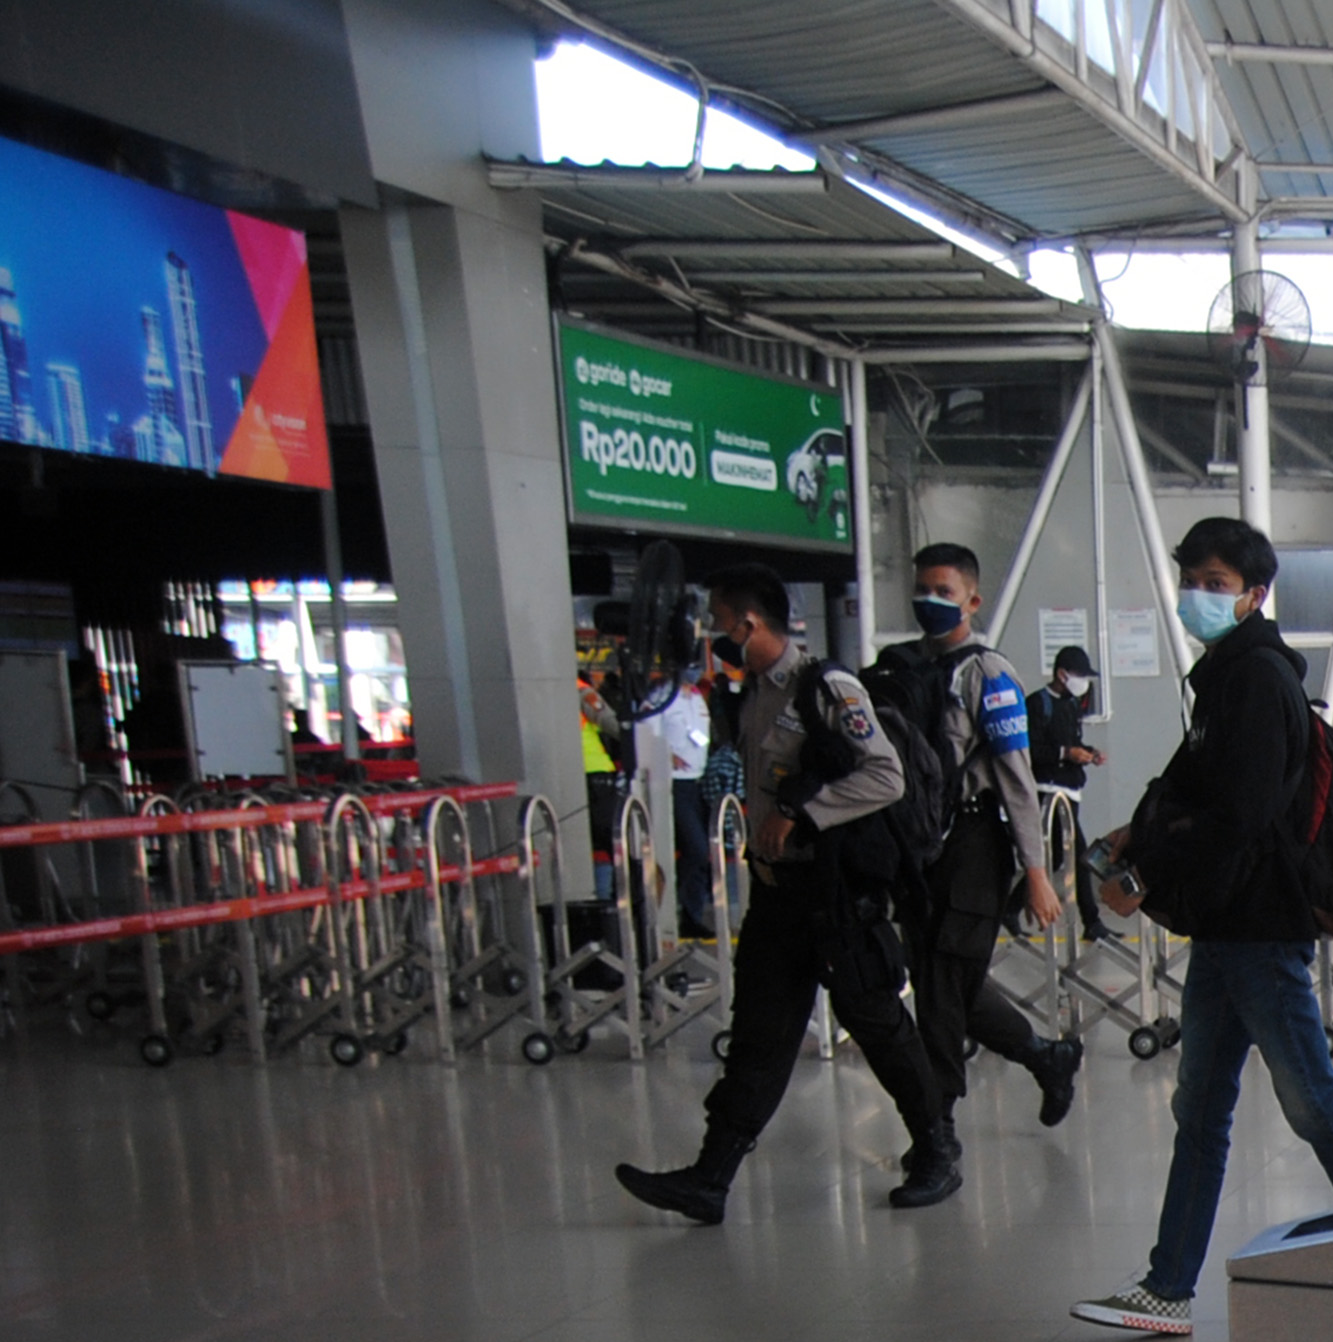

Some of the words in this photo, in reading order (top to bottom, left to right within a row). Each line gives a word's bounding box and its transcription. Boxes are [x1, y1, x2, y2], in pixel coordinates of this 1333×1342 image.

[590, 363, 626, 386] goride
[643, 376, 673, 397] gocar
[580, 421, 696, 479] Rp20.000
